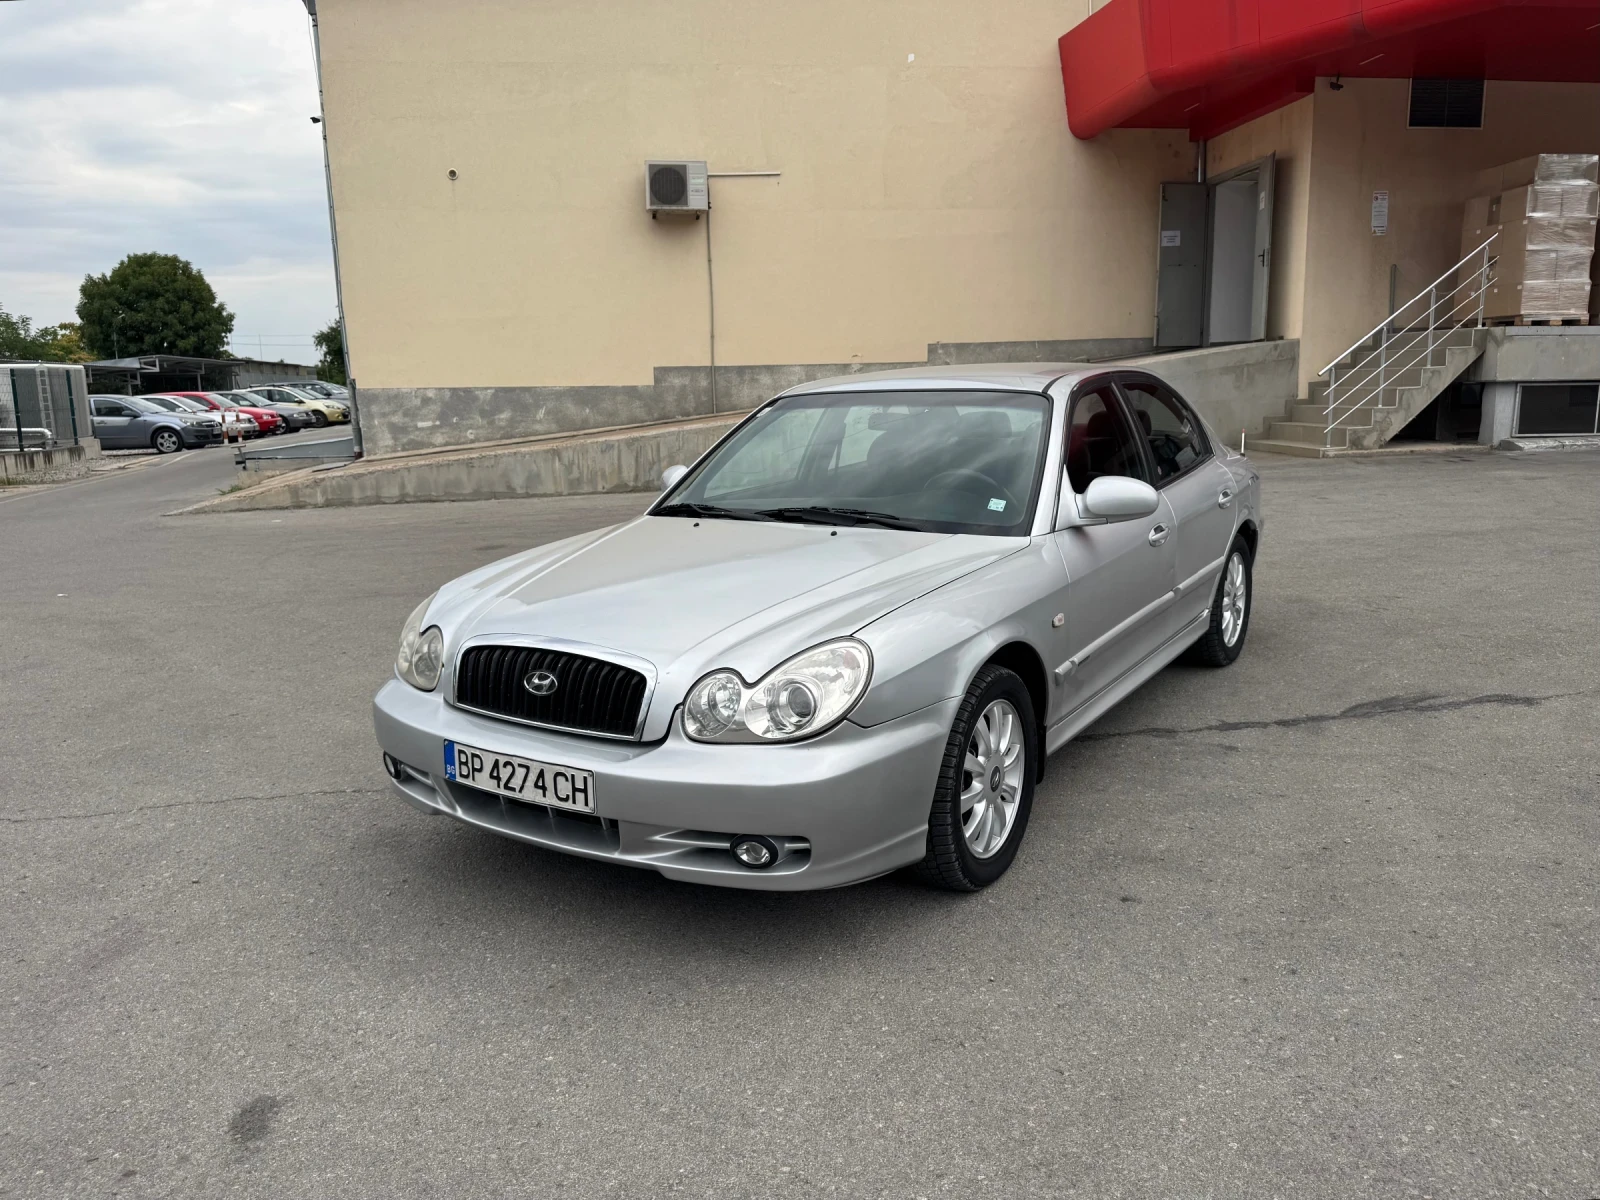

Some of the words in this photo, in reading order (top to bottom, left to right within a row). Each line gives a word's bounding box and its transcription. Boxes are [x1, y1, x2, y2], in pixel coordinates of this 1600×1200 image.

[446, 764, 456, 775] BG
[457, 748, 484, 782] BP
[489, 758, 548, 798] 4274
[553, 771, 589, 807] CH
